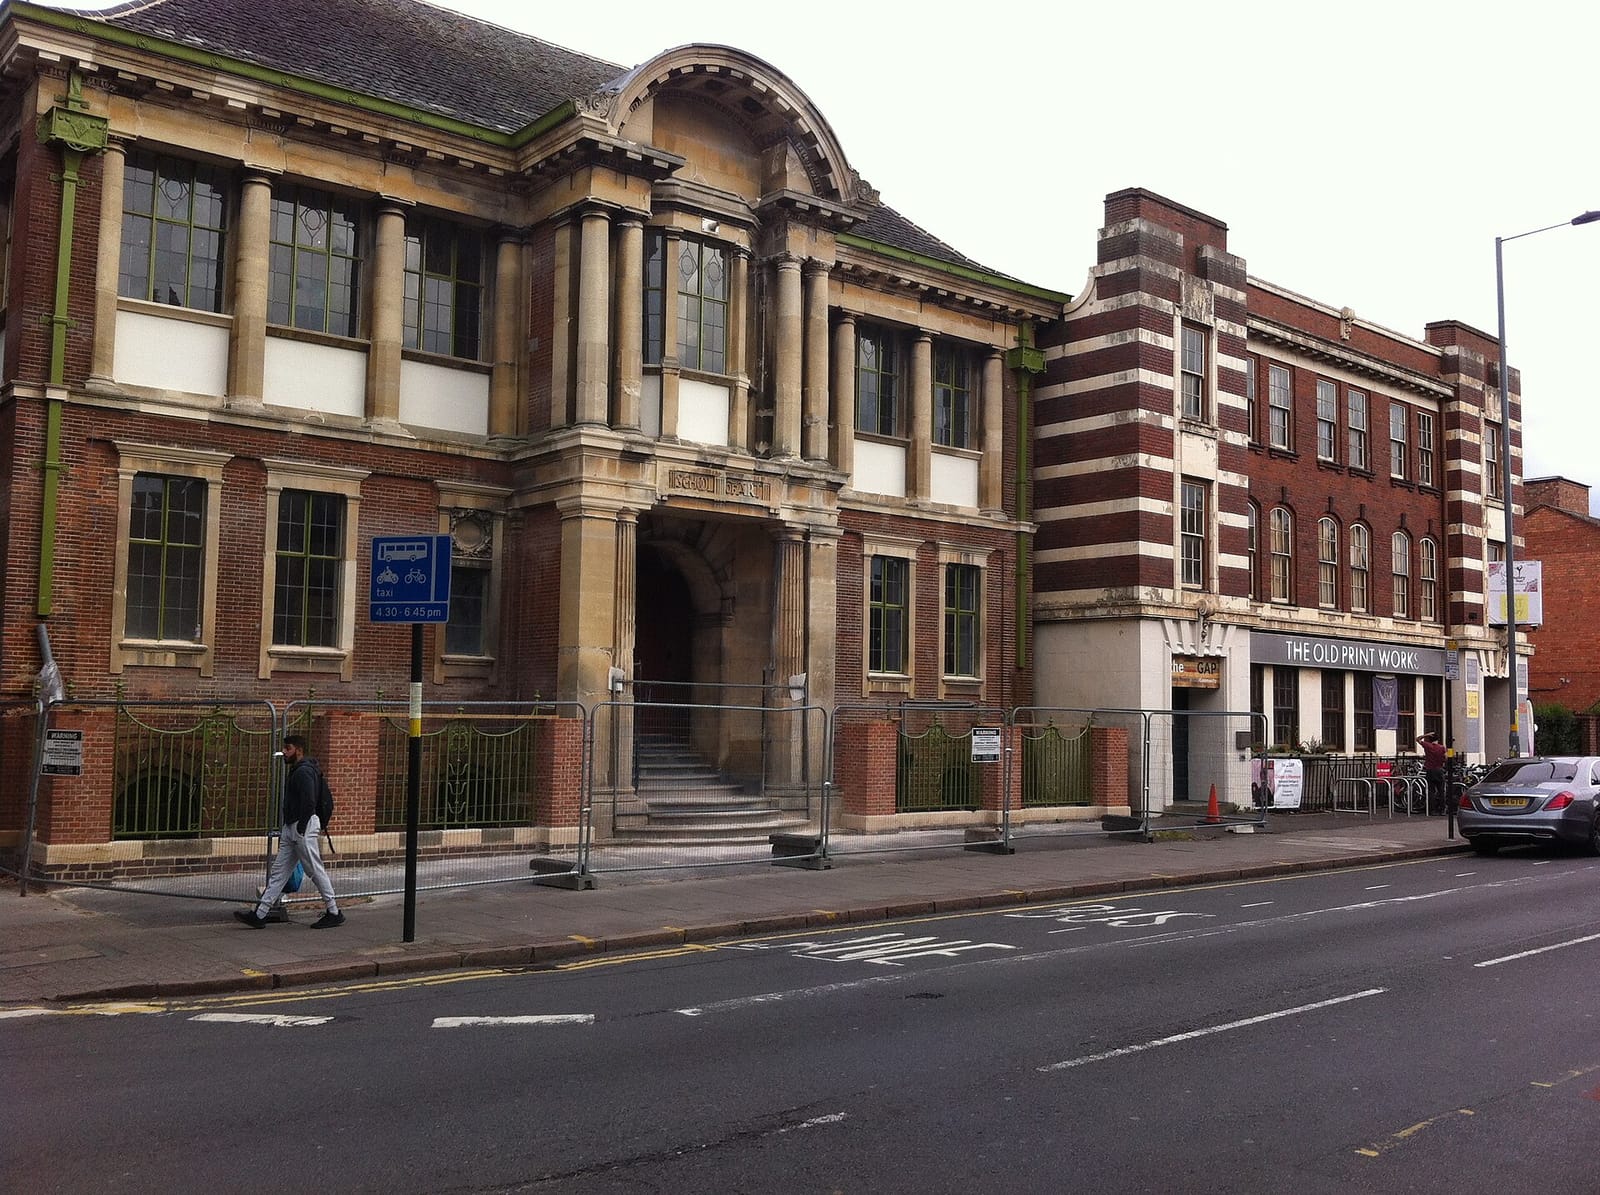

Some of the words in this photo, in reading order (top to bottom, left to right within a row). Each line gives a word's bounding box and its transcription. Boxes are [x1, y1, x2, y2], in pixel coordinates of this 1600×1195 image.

[376, 587, 393, 597] taxi
[375, 607, 398, 617] 4.30
[427, 609, 441, 619] pm
[1286, 640, 1310, 662] THE
[1313, 643, 1339, 664] OLD
[1342, 646, 1375, 667] PRINT
[1378, 649, 1420, 671] WORKS
[1197, 661, 1217, 674] GAP
[51, 732, 78, 740] WARNING
[1004, 904, 1217, 928] BUS
